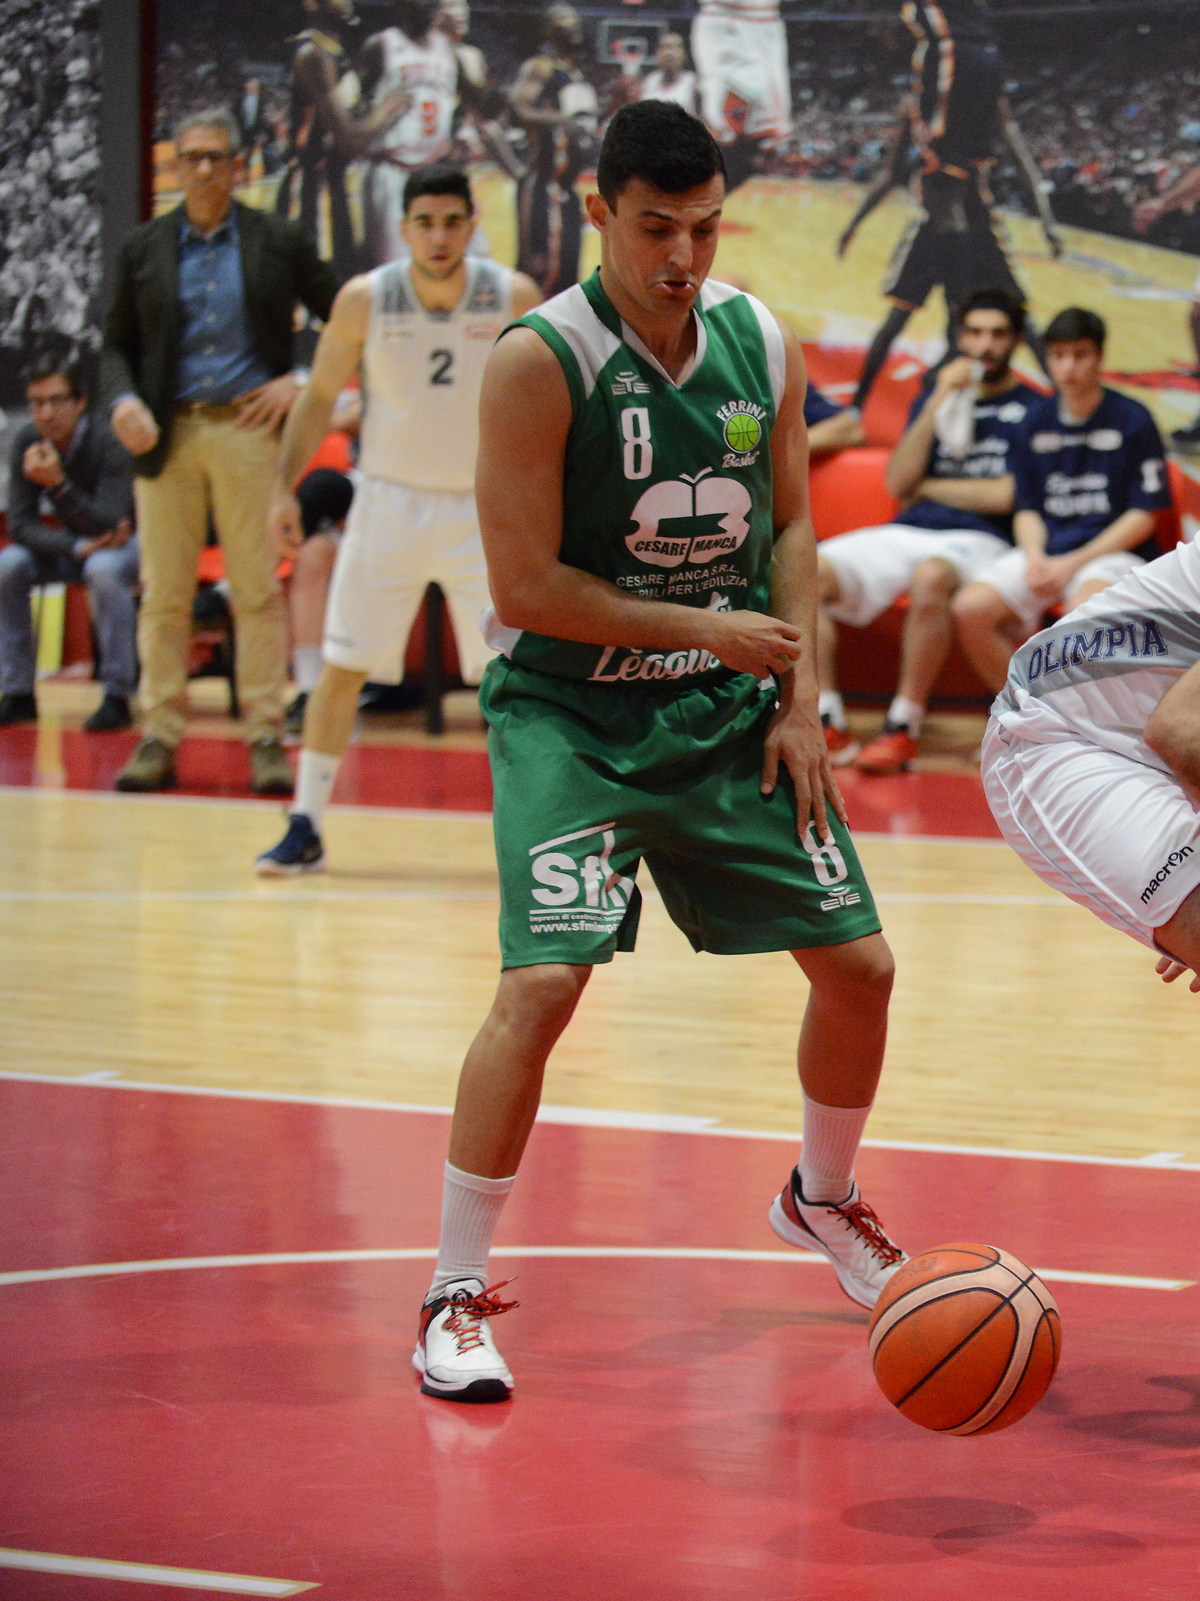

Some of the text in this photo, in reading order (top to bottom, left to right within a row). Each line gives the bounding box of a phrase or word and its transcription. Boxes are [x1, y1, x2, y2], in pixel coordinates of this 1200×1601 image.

[430, 348, 453, 385] 2
[716, 400, 767, 422] FERRINI
[621, 407, 653, 480] 8
[634, 536, 737, 556] CESARE MANCA
[616, 574, 665, 587] CESARE
[711, 563, 740, 575] S.R.L.
[667, 584, 692, 596] PER
[1028, 619, 1169, 684] OLIMPIA
[799, 820, 848, 887] 8
[1140, 846, 1195, 905] macron
